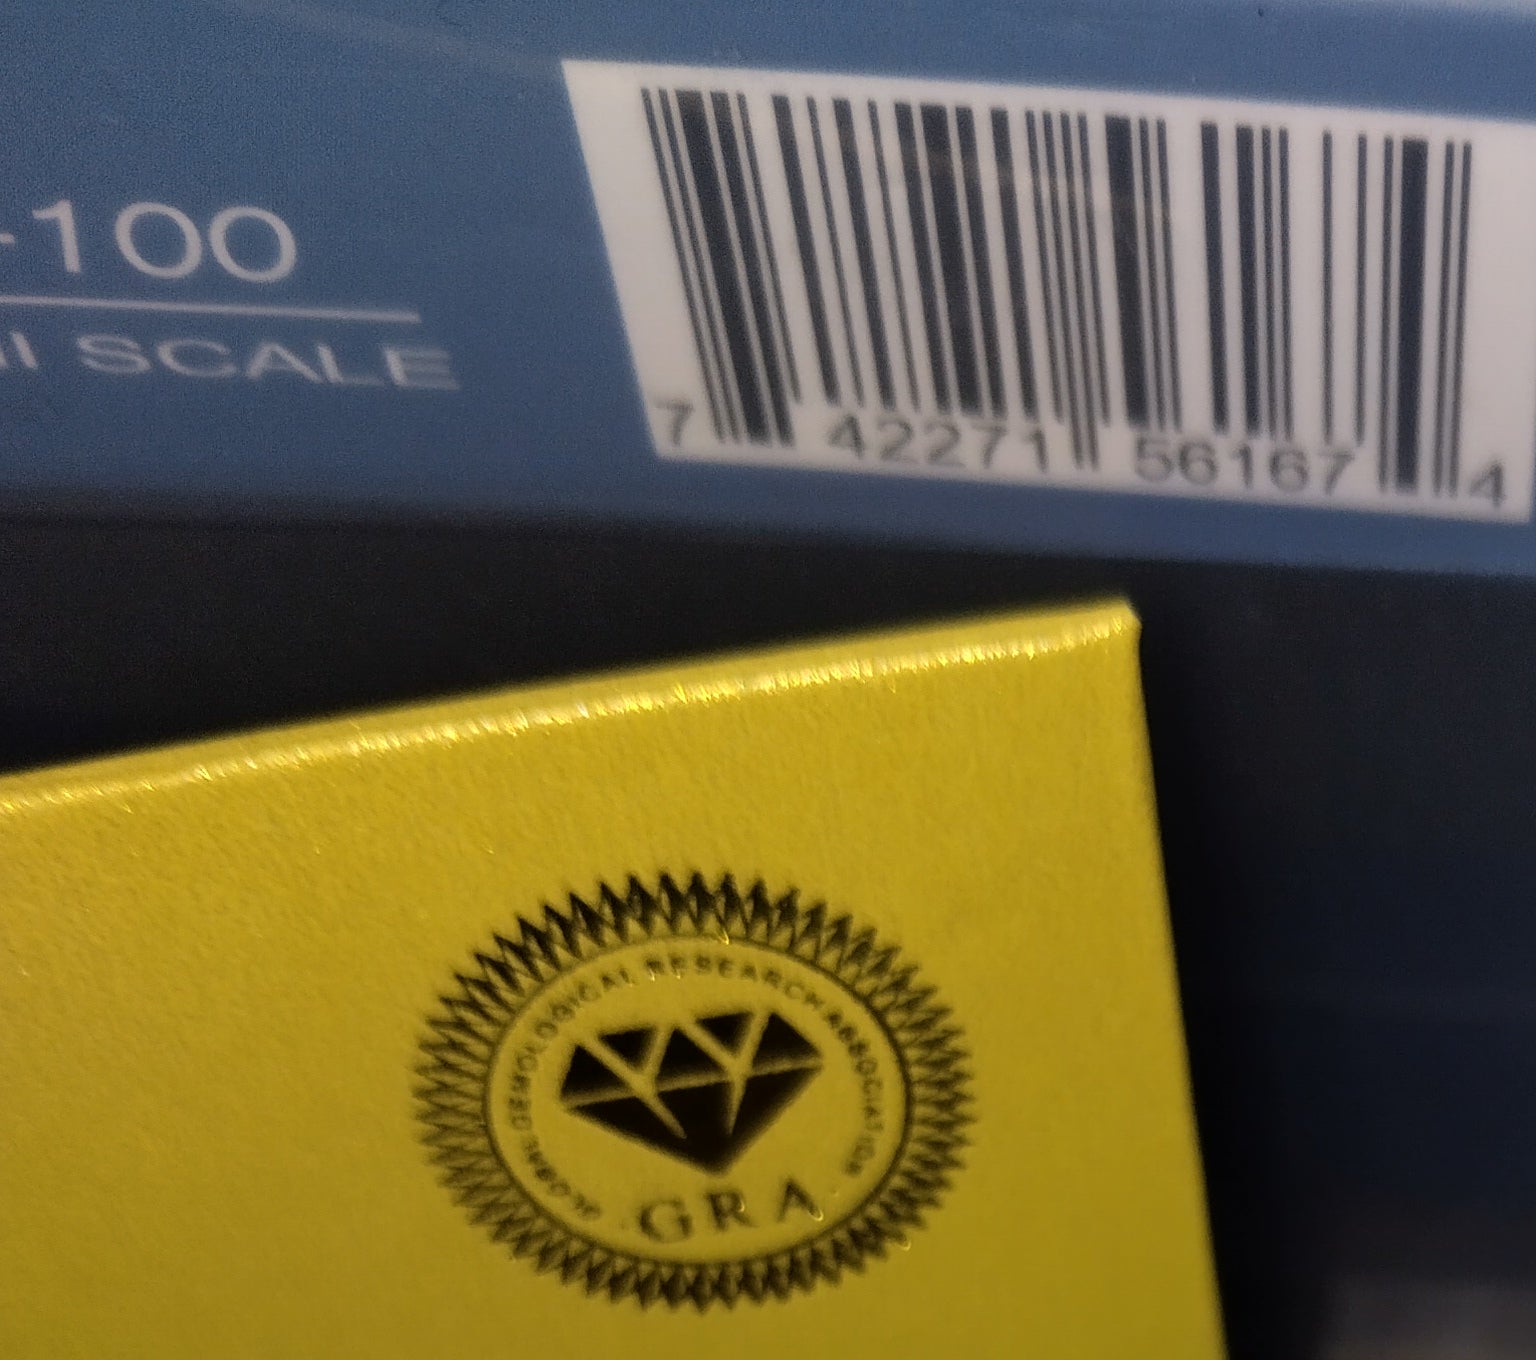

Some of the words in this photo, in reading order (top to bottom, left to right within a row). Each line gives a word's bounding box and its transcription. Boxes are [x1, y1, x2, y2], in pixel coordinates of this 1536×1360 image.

[76, 334, 461, 392] SCALE
[659, 402, 695, 447] 7
[826, 413, 1052, 474] 42271
[1133, 439, 1355, 492] 56167
[1469, 460, 1507, 507] 4
[637, 1174, 828, 1243] GRA
